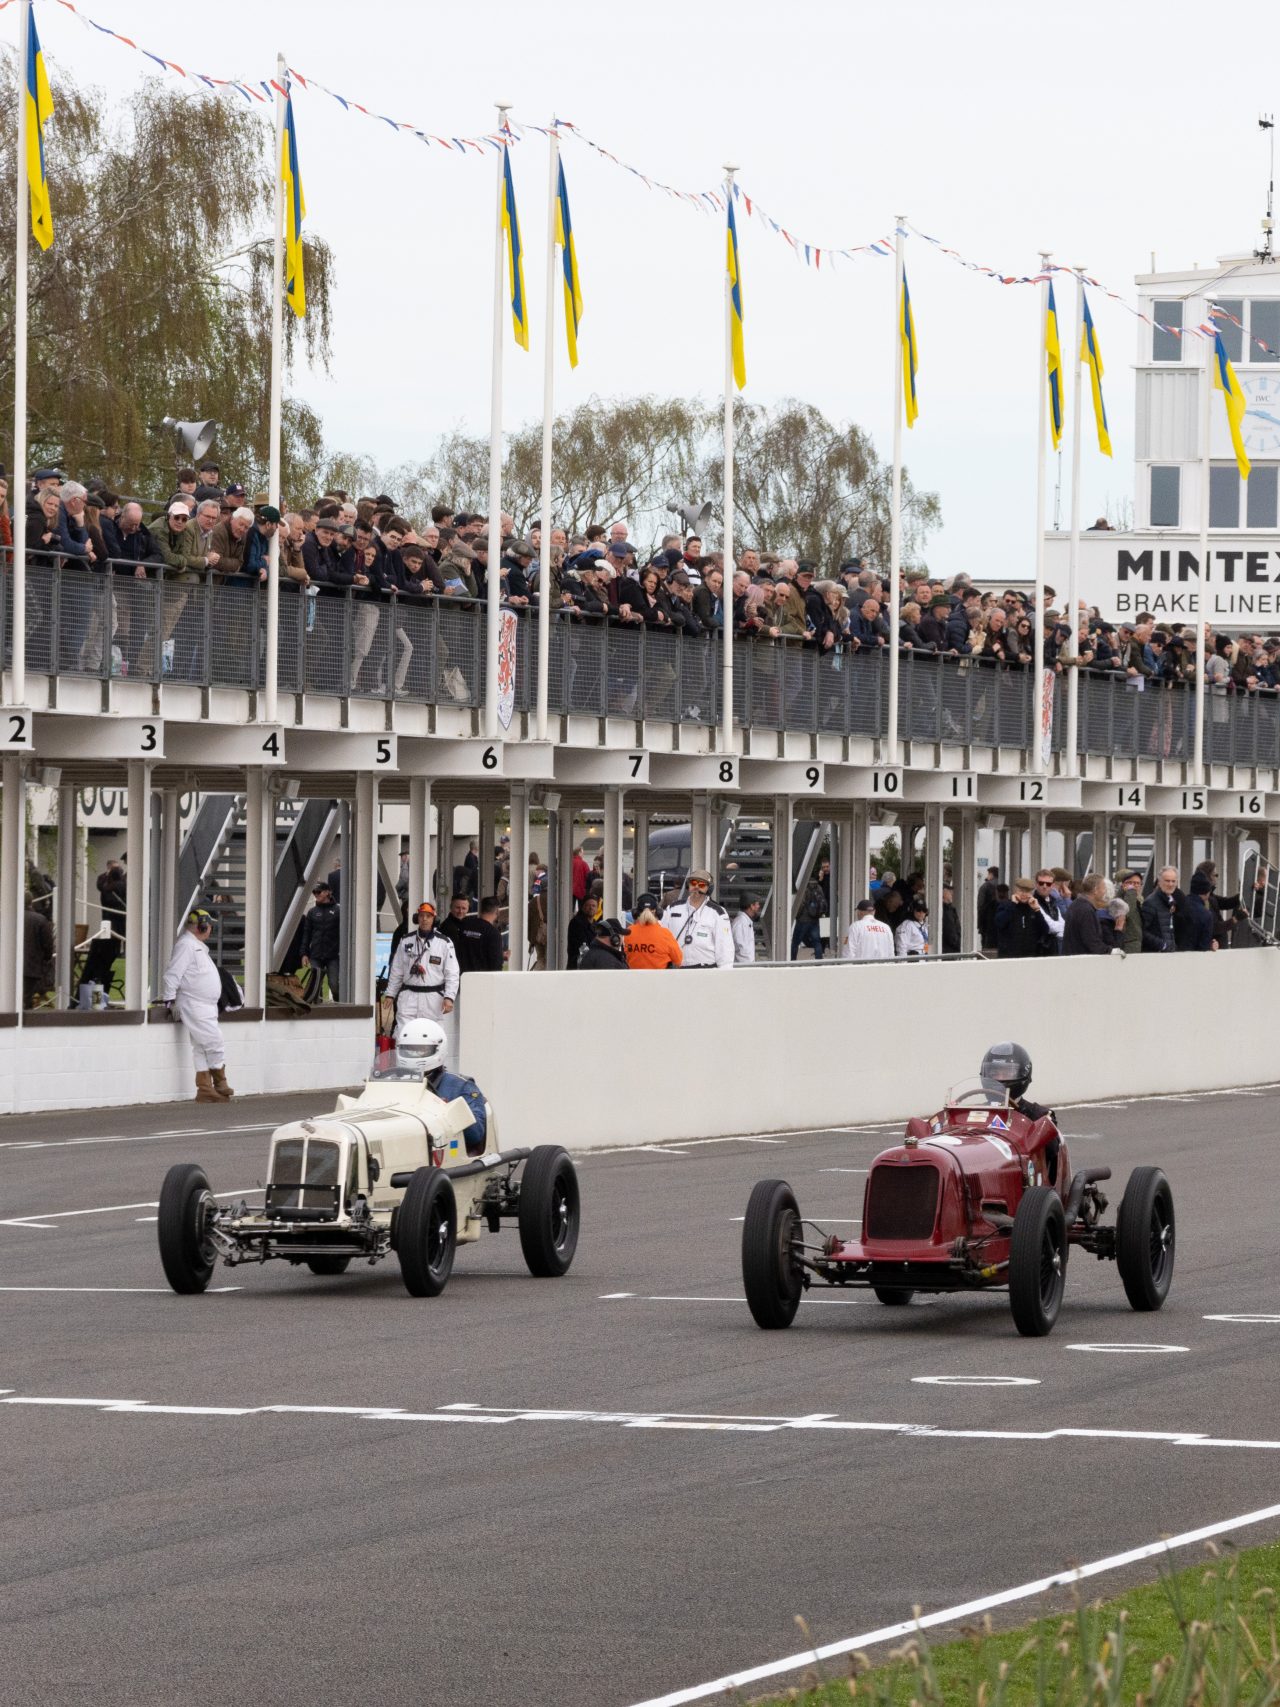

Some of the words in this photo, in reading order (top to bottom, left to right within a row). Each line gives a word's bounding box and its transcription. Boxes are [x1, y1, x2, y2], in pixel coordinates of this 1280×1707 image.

[1116, 593, 1199, 612] BRAKE
[8, 715, 26, 743] 2
[140, 724, 157, 751] 3
[262, 732, 280, 757] 4
[376, 739, 391, 764] 5
[481, 745, 498, 770] 6
[628, 755, 644, 778] 7
[718, 760, 734, 783] 8
[805, 766, 821, 788] 9
[873, 771, 899, 793] 10
[952, 776, 973, 797] 11
[1020, 781, 1044, 801] 12
[1118, 787, 1142, 806] 14
[1182, 791, 1204, 810] 15
[1239, 795, 1261, 814] 16
